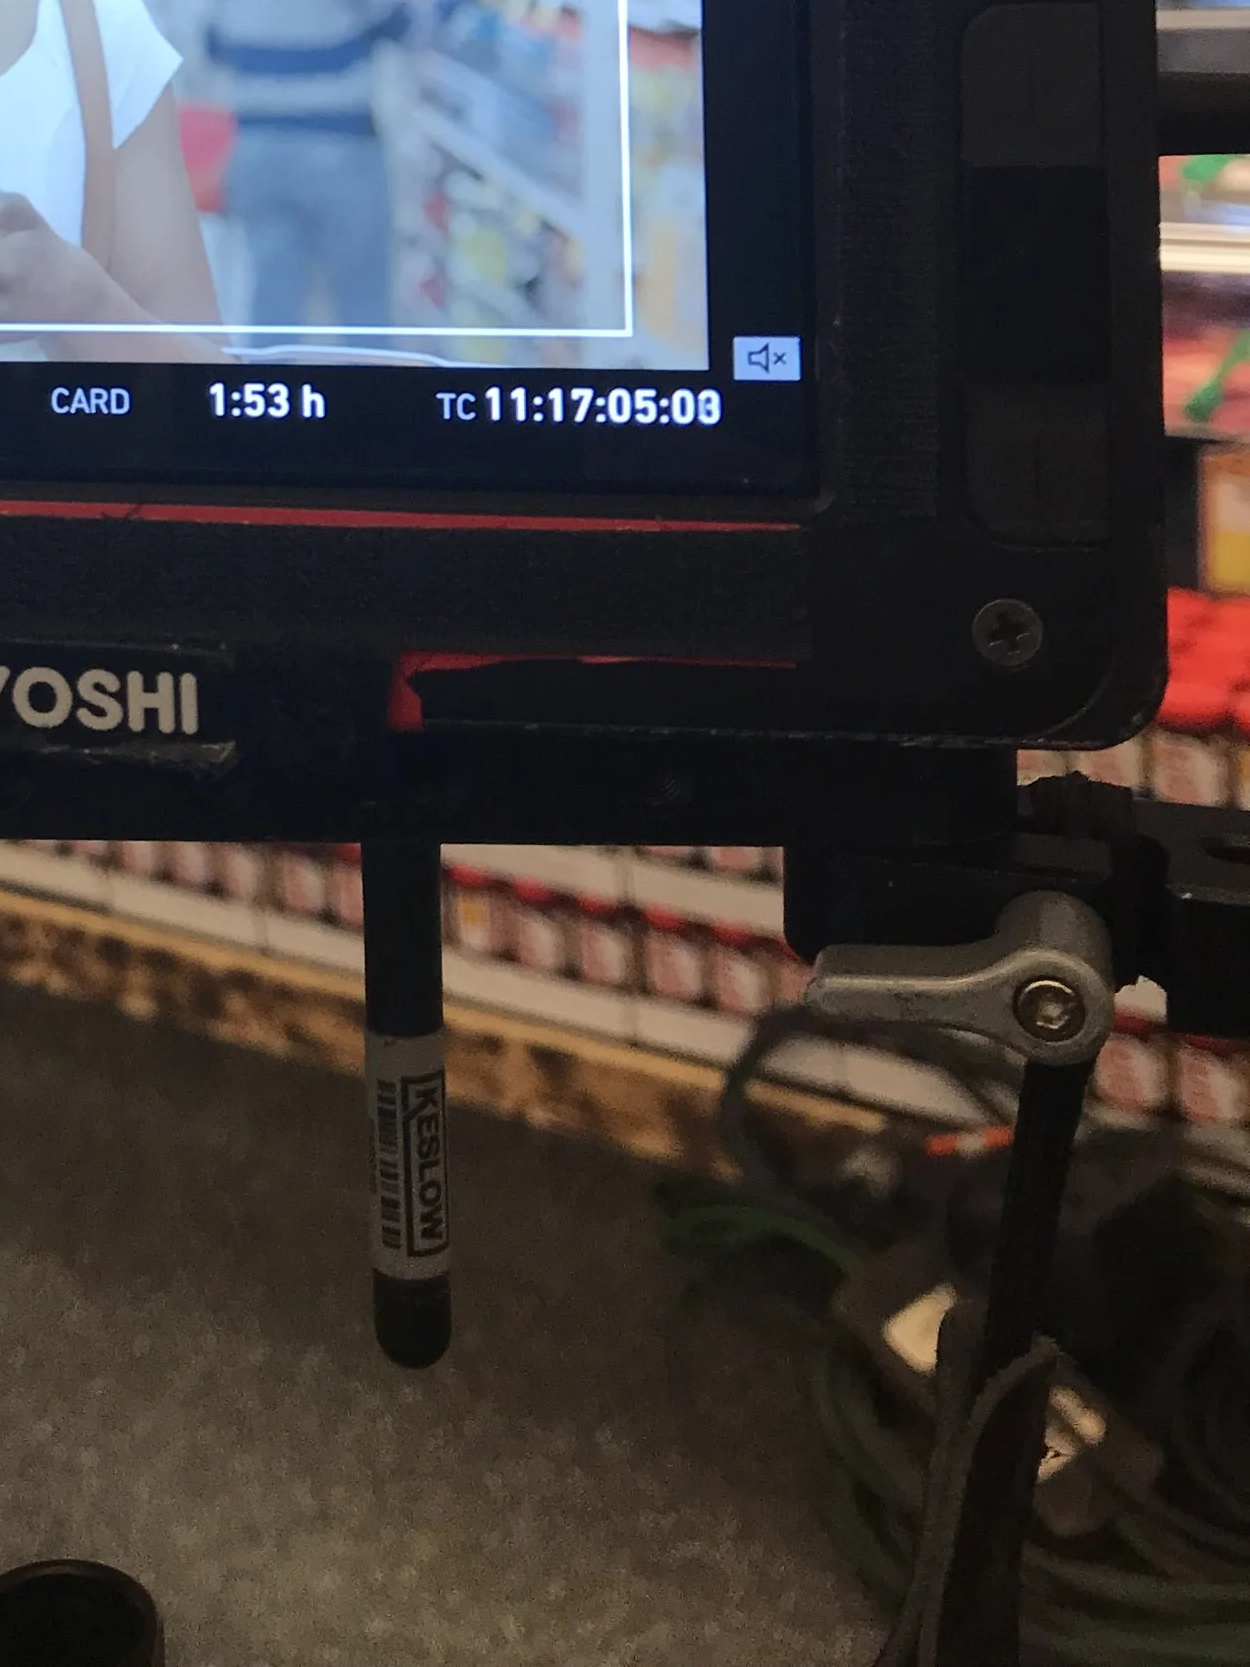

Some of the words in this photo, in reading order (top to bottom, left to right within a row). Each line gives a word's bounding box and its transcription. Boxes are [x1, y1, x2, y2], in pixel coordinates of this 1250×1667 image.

[50, 386, 131, 415] CARD
[208, 382, 291, 419] 1:53
[300, 383, 326, 419] h
[435, 392, 477, 421] TC
[412, 1086, 443, 1240] KESLOW
